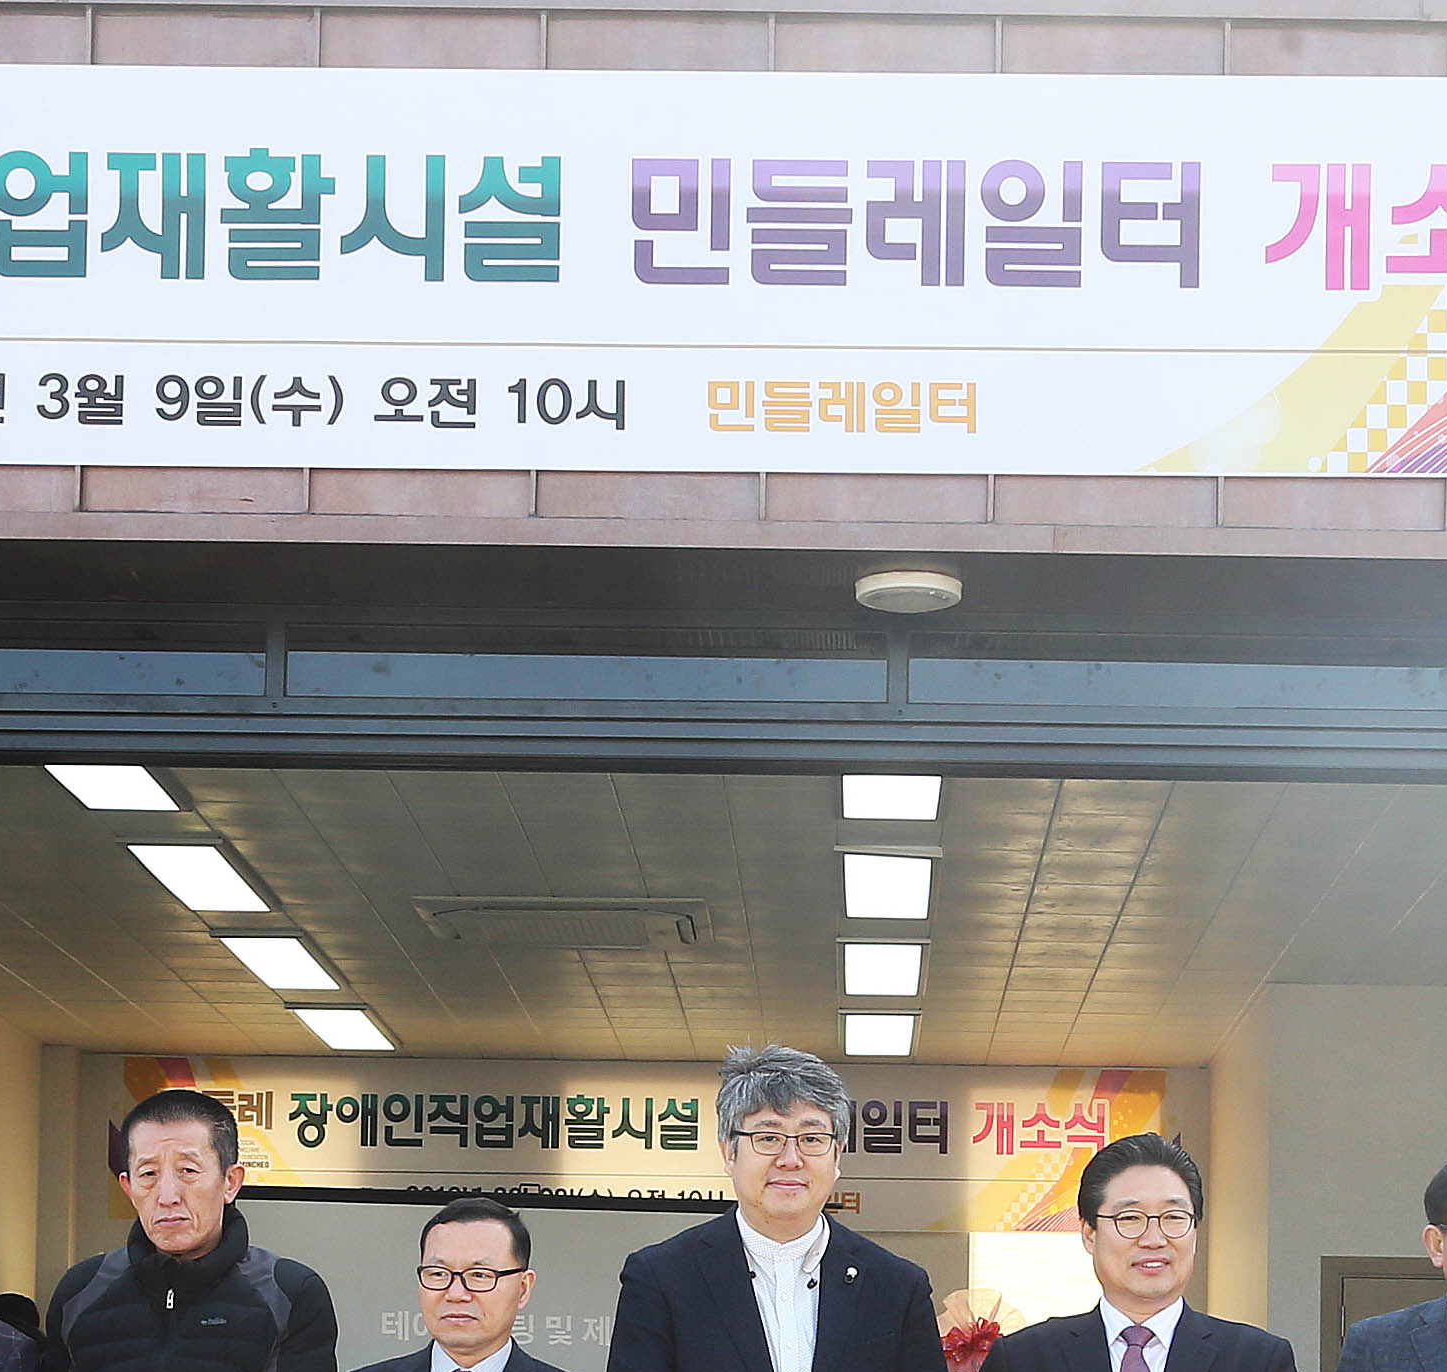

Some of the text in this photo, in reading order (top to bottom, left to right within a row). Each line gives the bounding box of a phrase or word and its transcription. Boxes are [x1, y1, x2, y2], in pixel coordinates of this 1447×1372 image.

[631, 158, 1202, 289] 민들레일터
[36, 373, 125, 426] 3월
[155, 374, 344, 428] 9일(수)
[374, 377, 476, 430] 오전
[508, 378, 627, 431] 10시
[707, 380, 977, 434] 민들레일터
[289, 1093, 699, 1151] 장애인직업재활시설
[972, 1102, 1105, 1155] 개소식
[546, 1315, 572, 1345] 및
